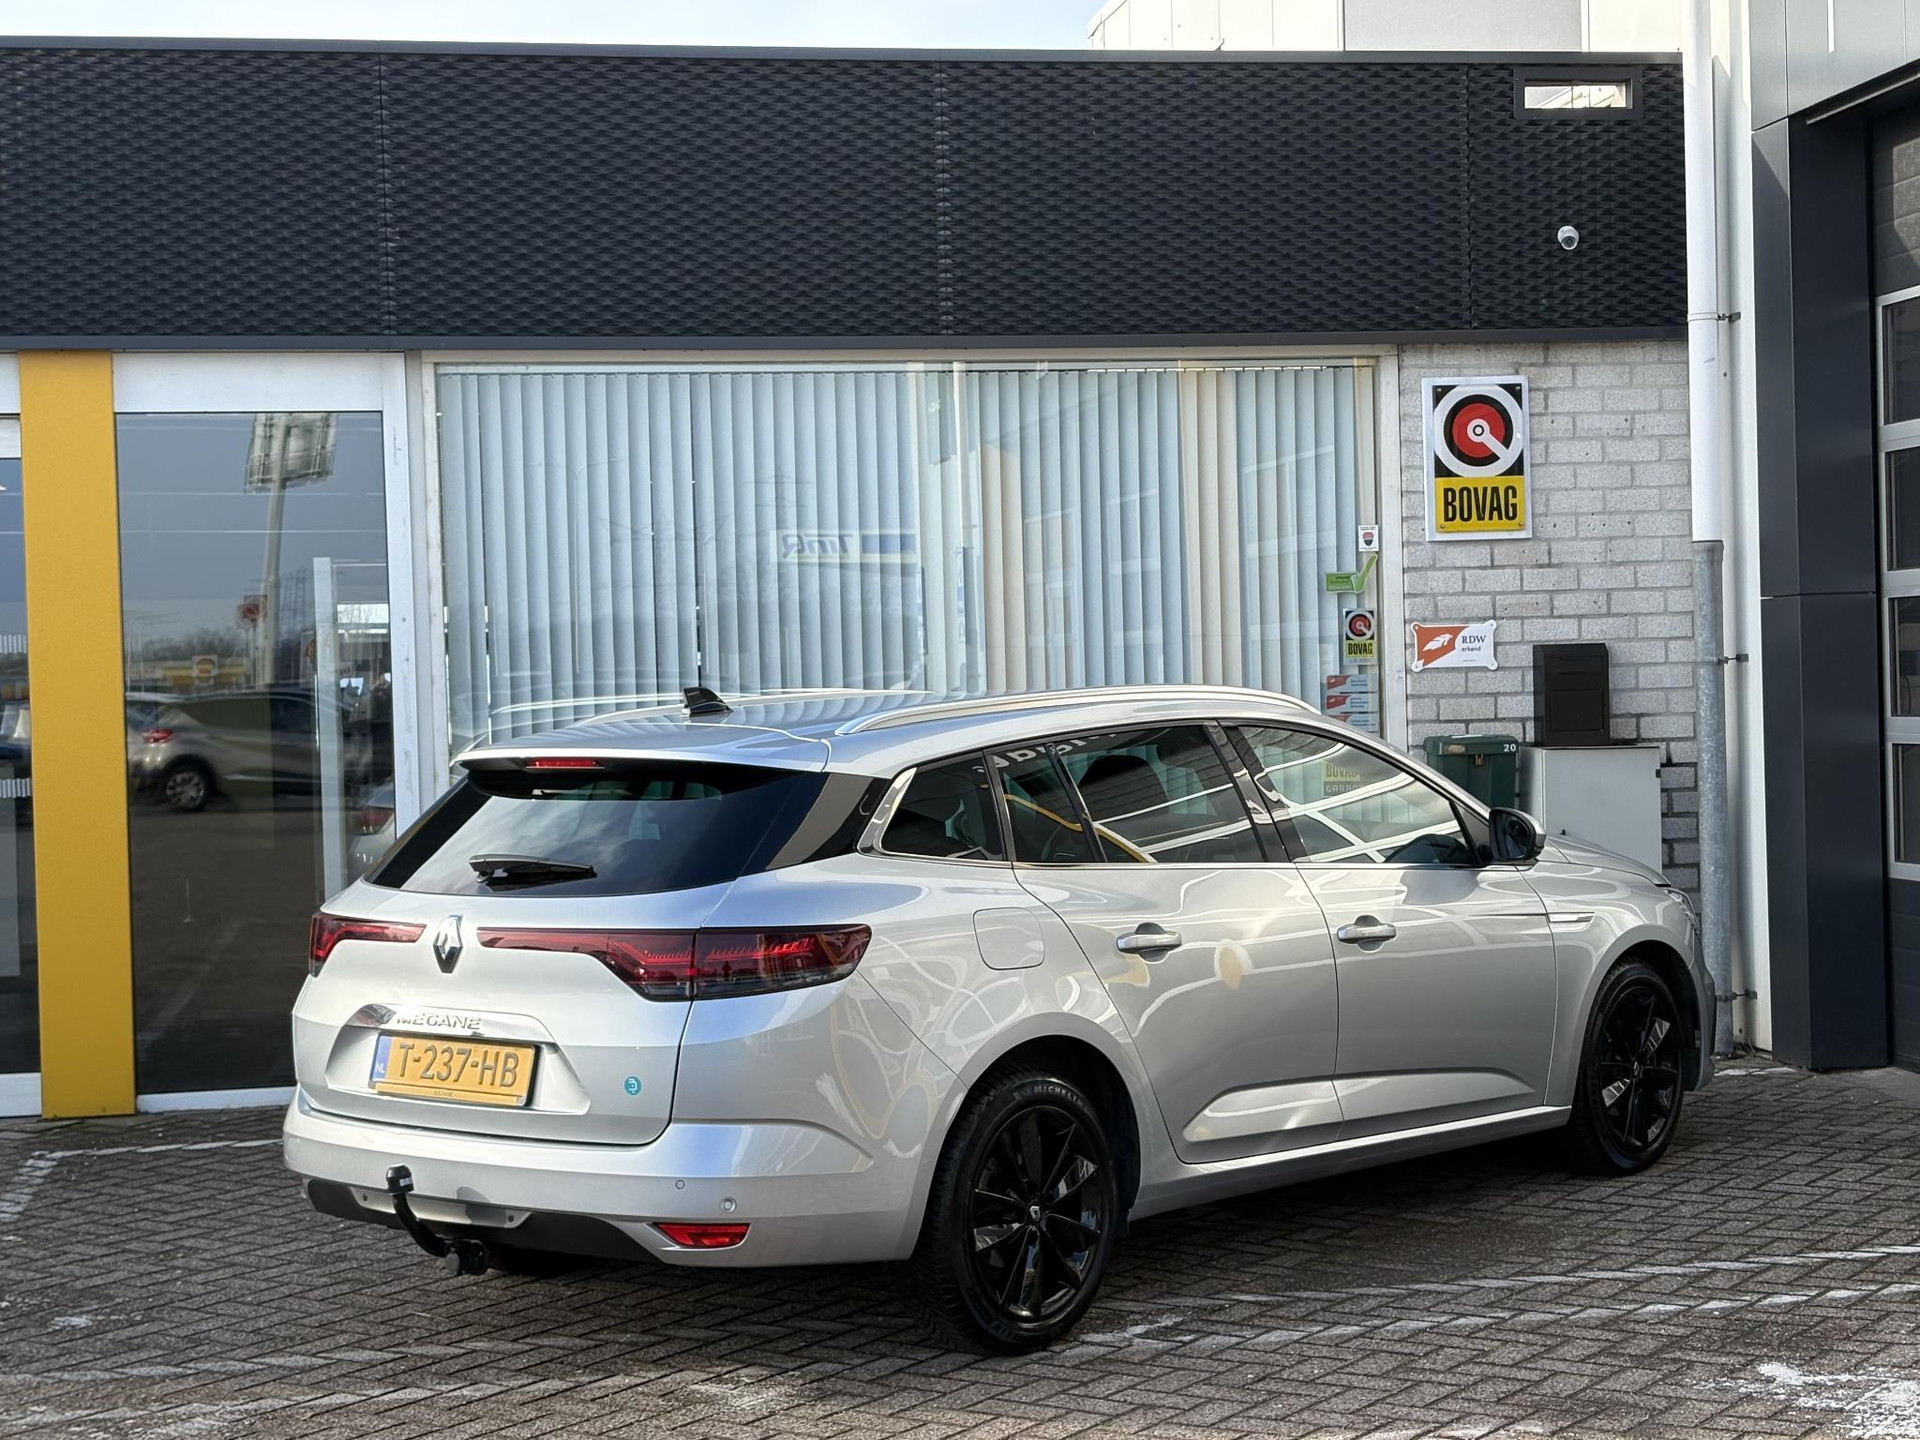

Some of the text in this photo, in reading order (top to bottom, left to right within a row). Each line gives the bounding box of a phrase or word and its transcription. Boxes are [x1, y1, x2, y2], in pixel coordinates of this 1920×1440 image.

[1443, 485, 1518, 522] BOVAG
[1461, 635, 1486, 644] RDW
[1347, 643, 1373, 656] BOVAG
[1503, 743, 1517, 752] 20
[375, 1062, 386, 1074] NL
[399, 1042, 520, 1088] T-237-HB
